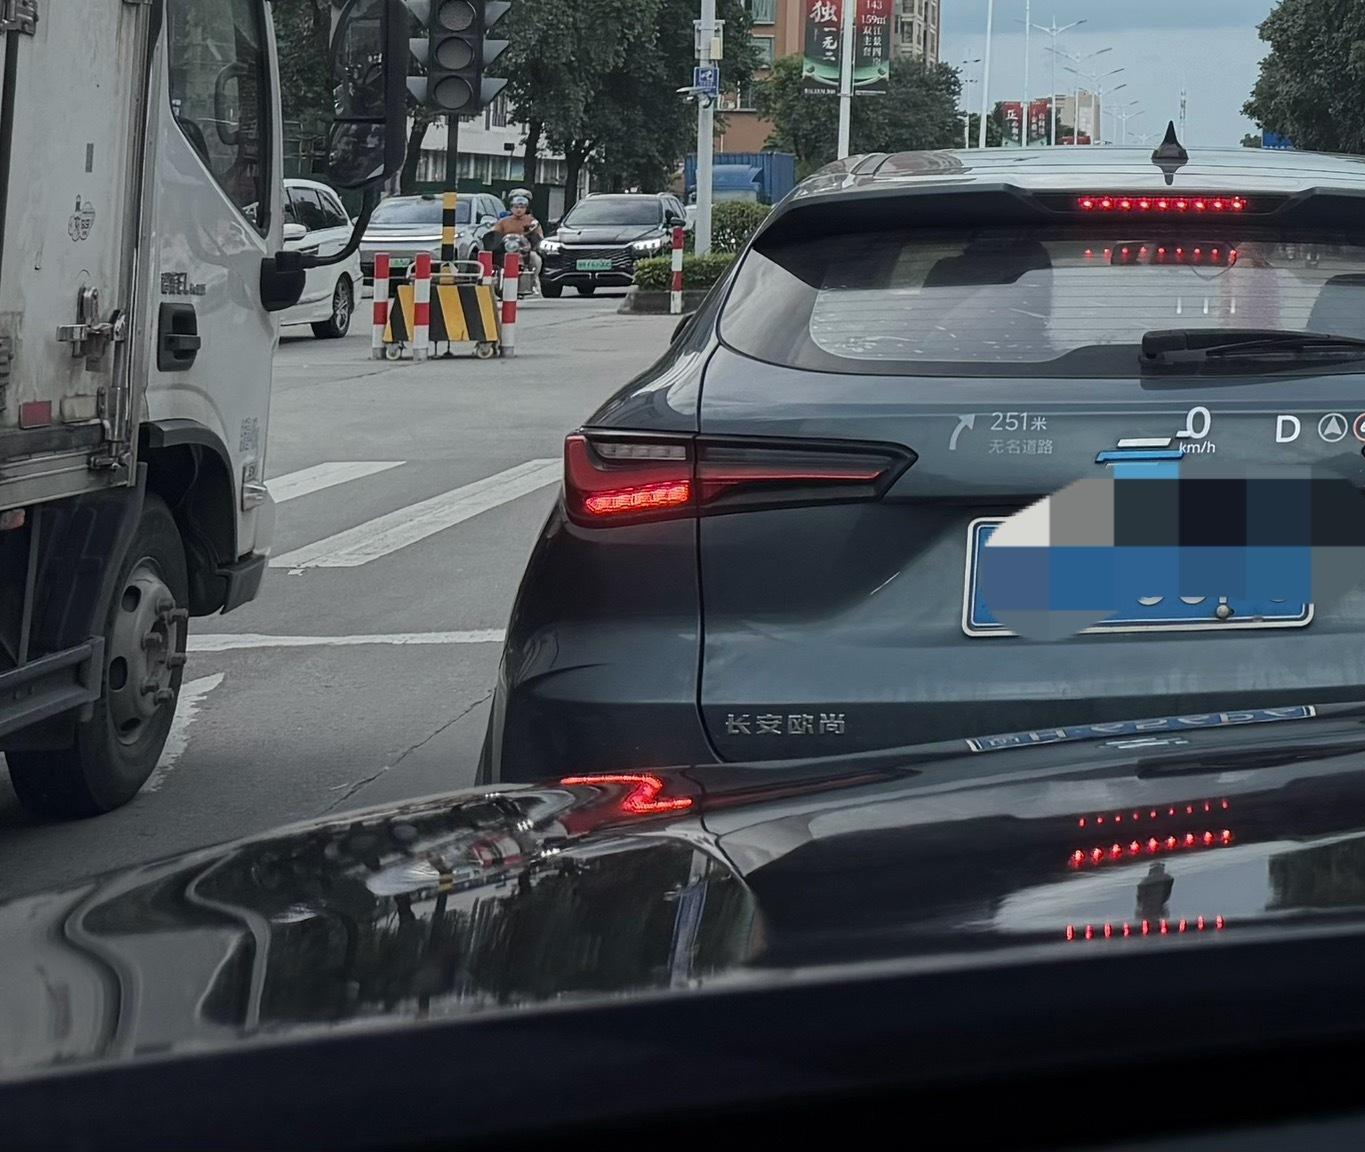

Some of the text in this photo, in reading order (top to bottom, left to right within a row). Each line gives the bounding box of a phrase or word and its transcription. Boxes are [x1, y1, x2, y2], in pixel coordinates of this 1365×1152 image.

[1275, 415, 1301, 442] D
[988, 439, 1053, 455] 无名道路
[1179, 440, 1216, 455] km/h
[725, 713, 847, 736] 长安欧尚
